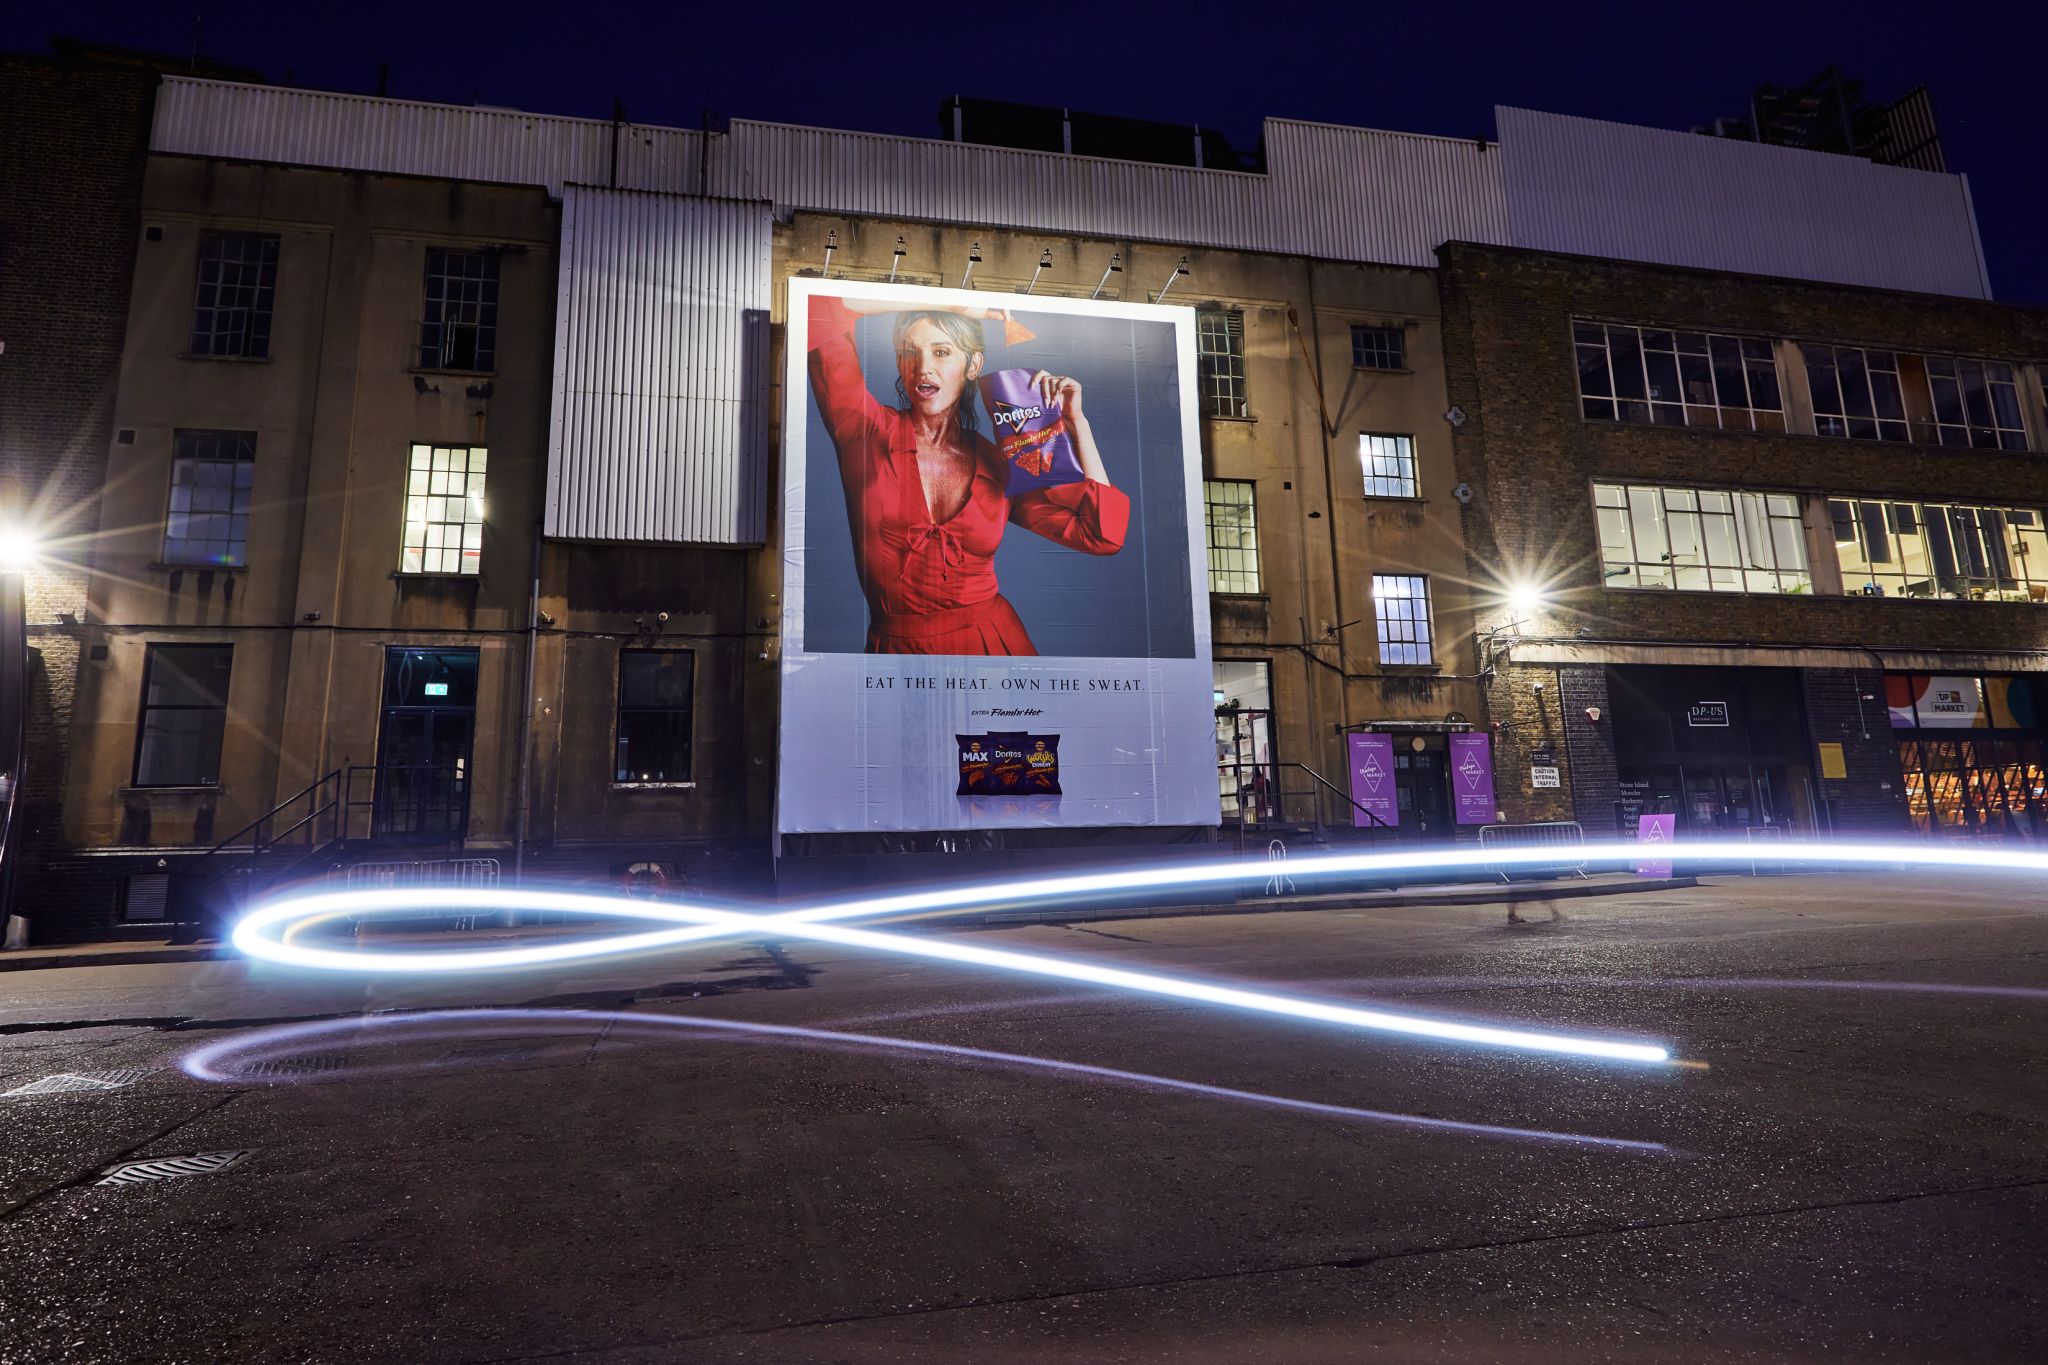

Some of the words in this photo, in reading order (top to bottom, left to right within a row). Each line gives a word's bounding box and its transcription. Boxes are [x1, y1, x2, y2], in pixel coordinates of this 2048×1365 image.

[993, 405, 1042, 426] Doritos
[865, 676, 895, 689] EAT
[904, 677, 936, 689] THE
[946, 678, 992, 690] HEAT.
[1001, 678, 1041, 690] OWN
[1049, 679, 1080, 691] THE
[1088, 679, 1145, 691] SWEAT.
[1938, 693, 1950, 701] UP
[1691, 706, 1723, 716] DP-US
[1934, 704, 1965, 713] MARKET
[962, 751, 989, 762] MAX
[995, 750, 1022, 758] Doritos
